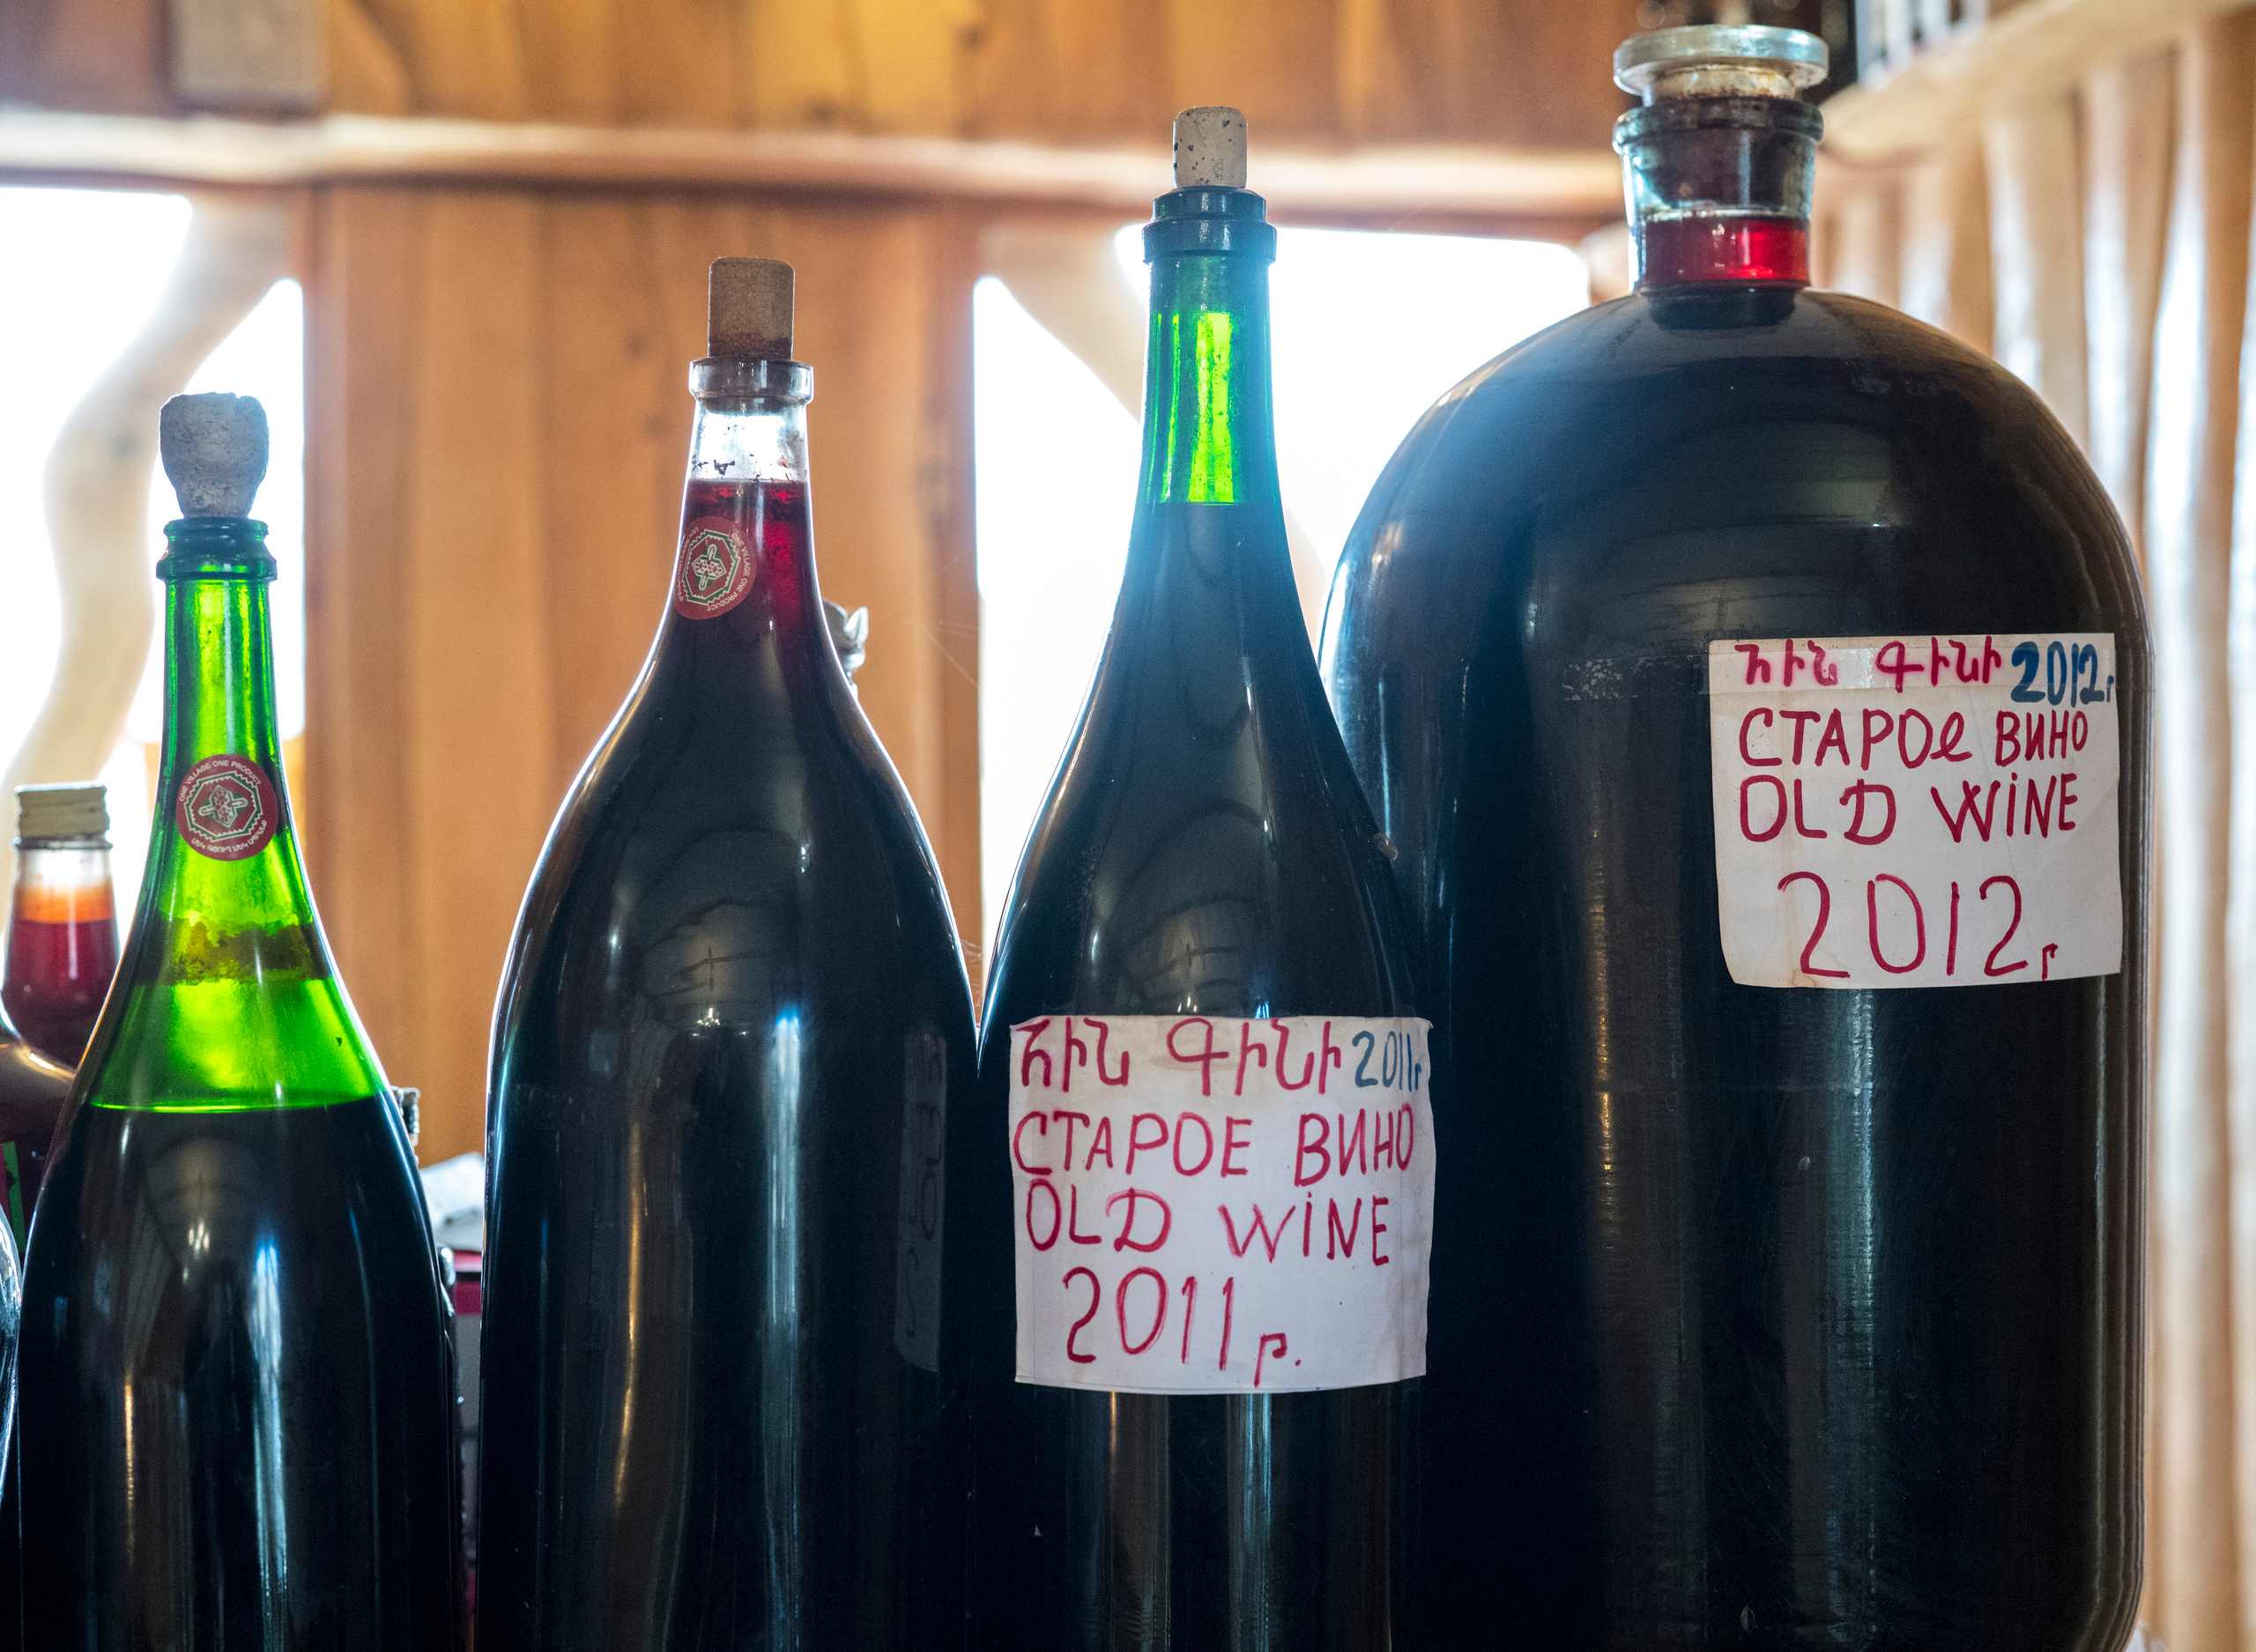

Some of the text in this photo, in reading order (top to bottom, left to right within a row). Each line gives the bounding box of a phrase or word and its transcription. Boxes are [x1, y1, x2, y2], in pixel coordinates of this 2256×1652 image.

[707, 532, 751, 611] ONE VILLAGE ONE PRODUCT
[1995, 709, 2089, 767] ВИНО
[179, 786, 188, 802] ONE
[186, 762, 212, 785] VILLAGE
[231, 760, 262, 785] PRODUCT
[1739, 774, 1896, 845] OLD
[1013, 1102, 1414, 1188] СТАРОЕ ВИНО
[1026, 1177, 1172, 1252] OLD
